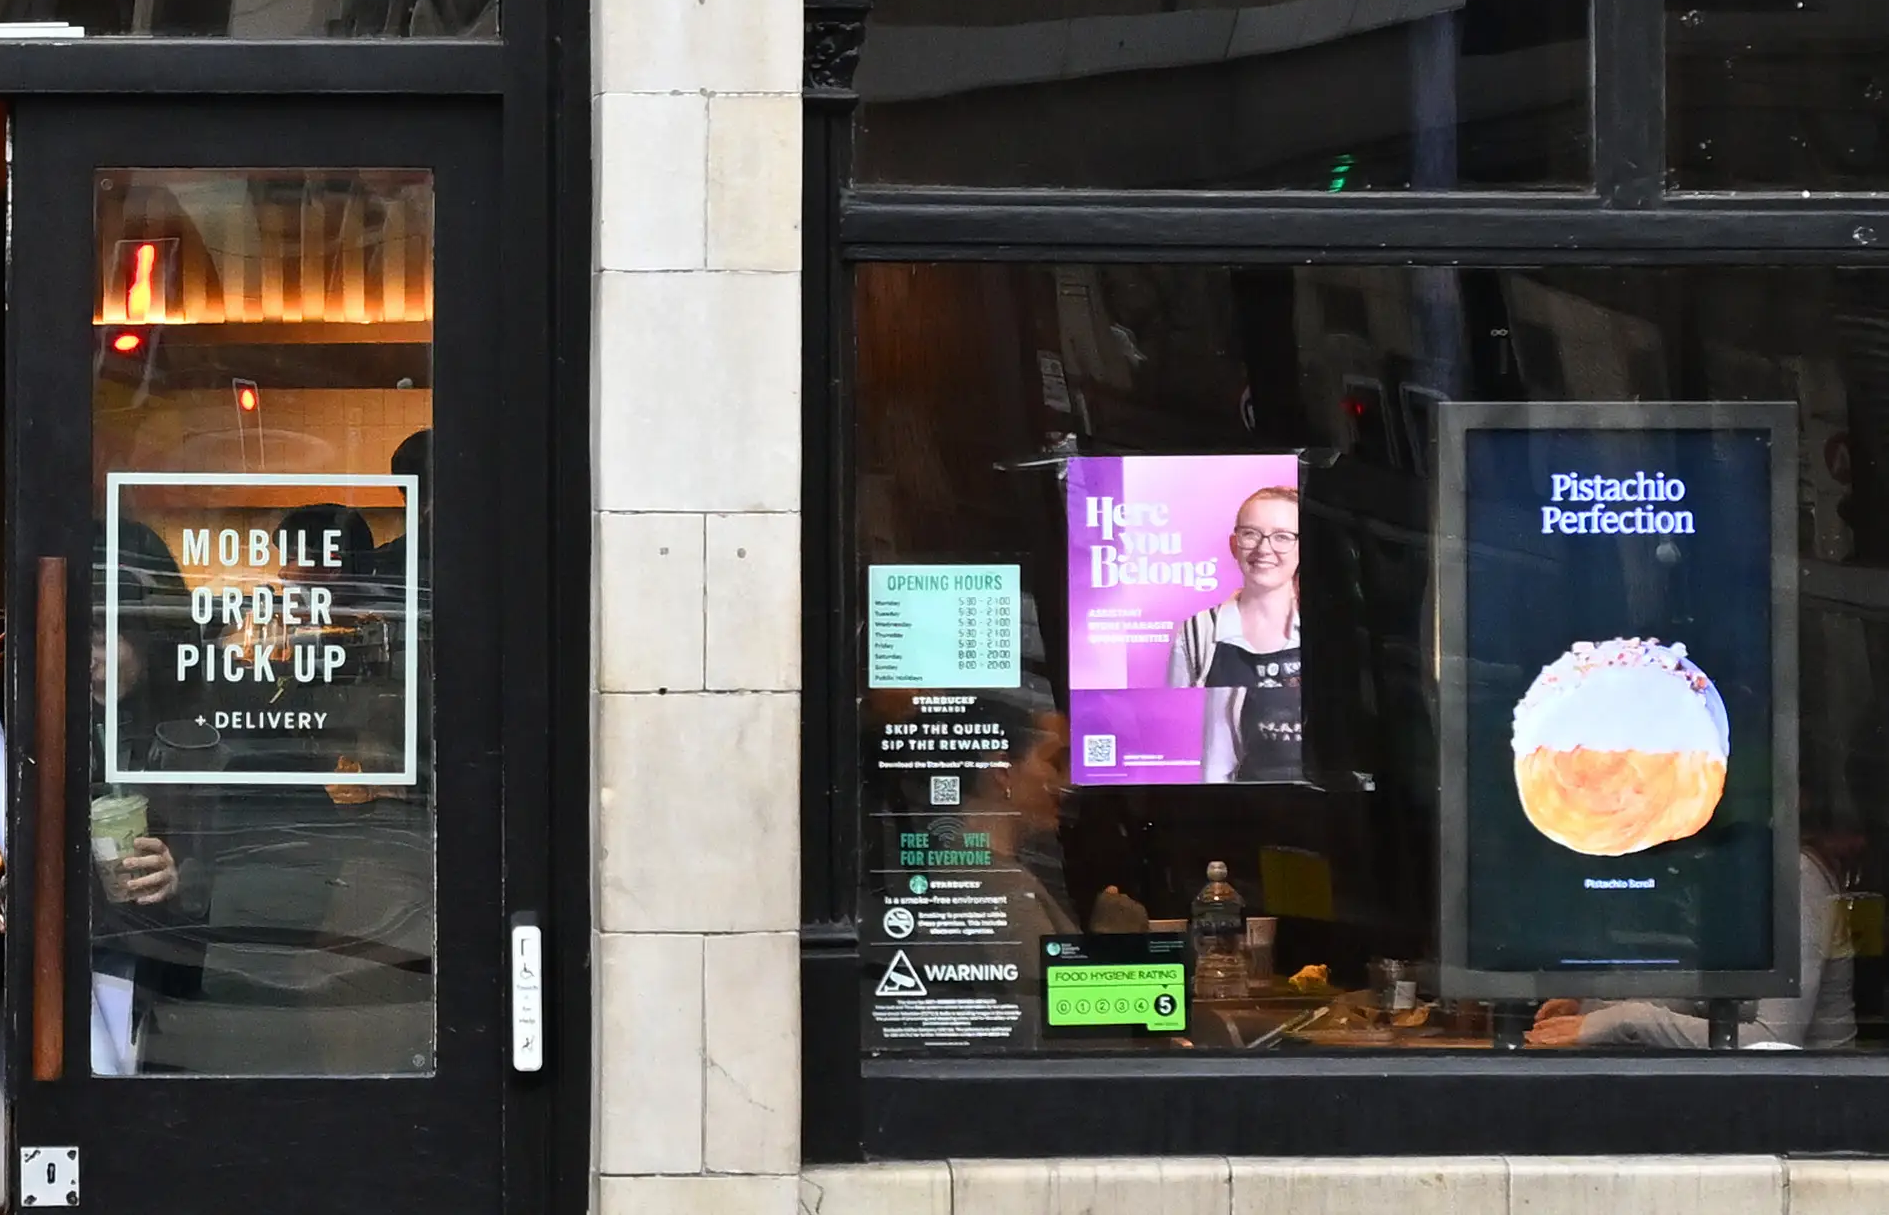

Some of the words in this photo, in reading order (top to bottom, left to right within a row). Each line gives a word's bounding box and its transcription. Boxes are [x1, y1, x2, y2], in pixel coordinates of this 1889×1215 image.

[1550, 471, 1686, 502] Pistachio
[1086, 496, 1169, 540] Here
[1541, 503, 1695, 534] Perfection
[182, 528, 342, 568] MOBILE
[1118, 531, 1183, 562] you
[1090, 545, 1219, 592] Belong
[887, 575, 949, 591] OPENING
[954, 575, 1003, 591] HOURS
[191, 587, 332, 625] ORDER
[177, 644, 276, 683] PICK
[294, 645, 347, 683] UP
[912, 696, 976, 705] STARBUCKS
[215, 711, 328, 729] DELIVERY
[885, 724, 918, 735] SKIP
[921, 724, 949, 735] THE
[953, 724, 1005, 736] QUEUE,
[881, 740, 904, 750] SIP
[909, 740, 935, 750] THE
[939, 739, 1010, 750] REWARDS
[900, 833, 929, 848] FREE
[963, 832, 990, 848] WIFI
[900, 851, 924, 866] FOR
[928, 851, 991, 865] EVERYONE
[924, 964, 1019, 981] WARNING
[1055, 971, 1088, 981] FOOD
[1090, 970, 1136, 981] HYGIENE
[1138, 969, 1177, 979] RATING
[1159, 996, 1172, 1014] 5
